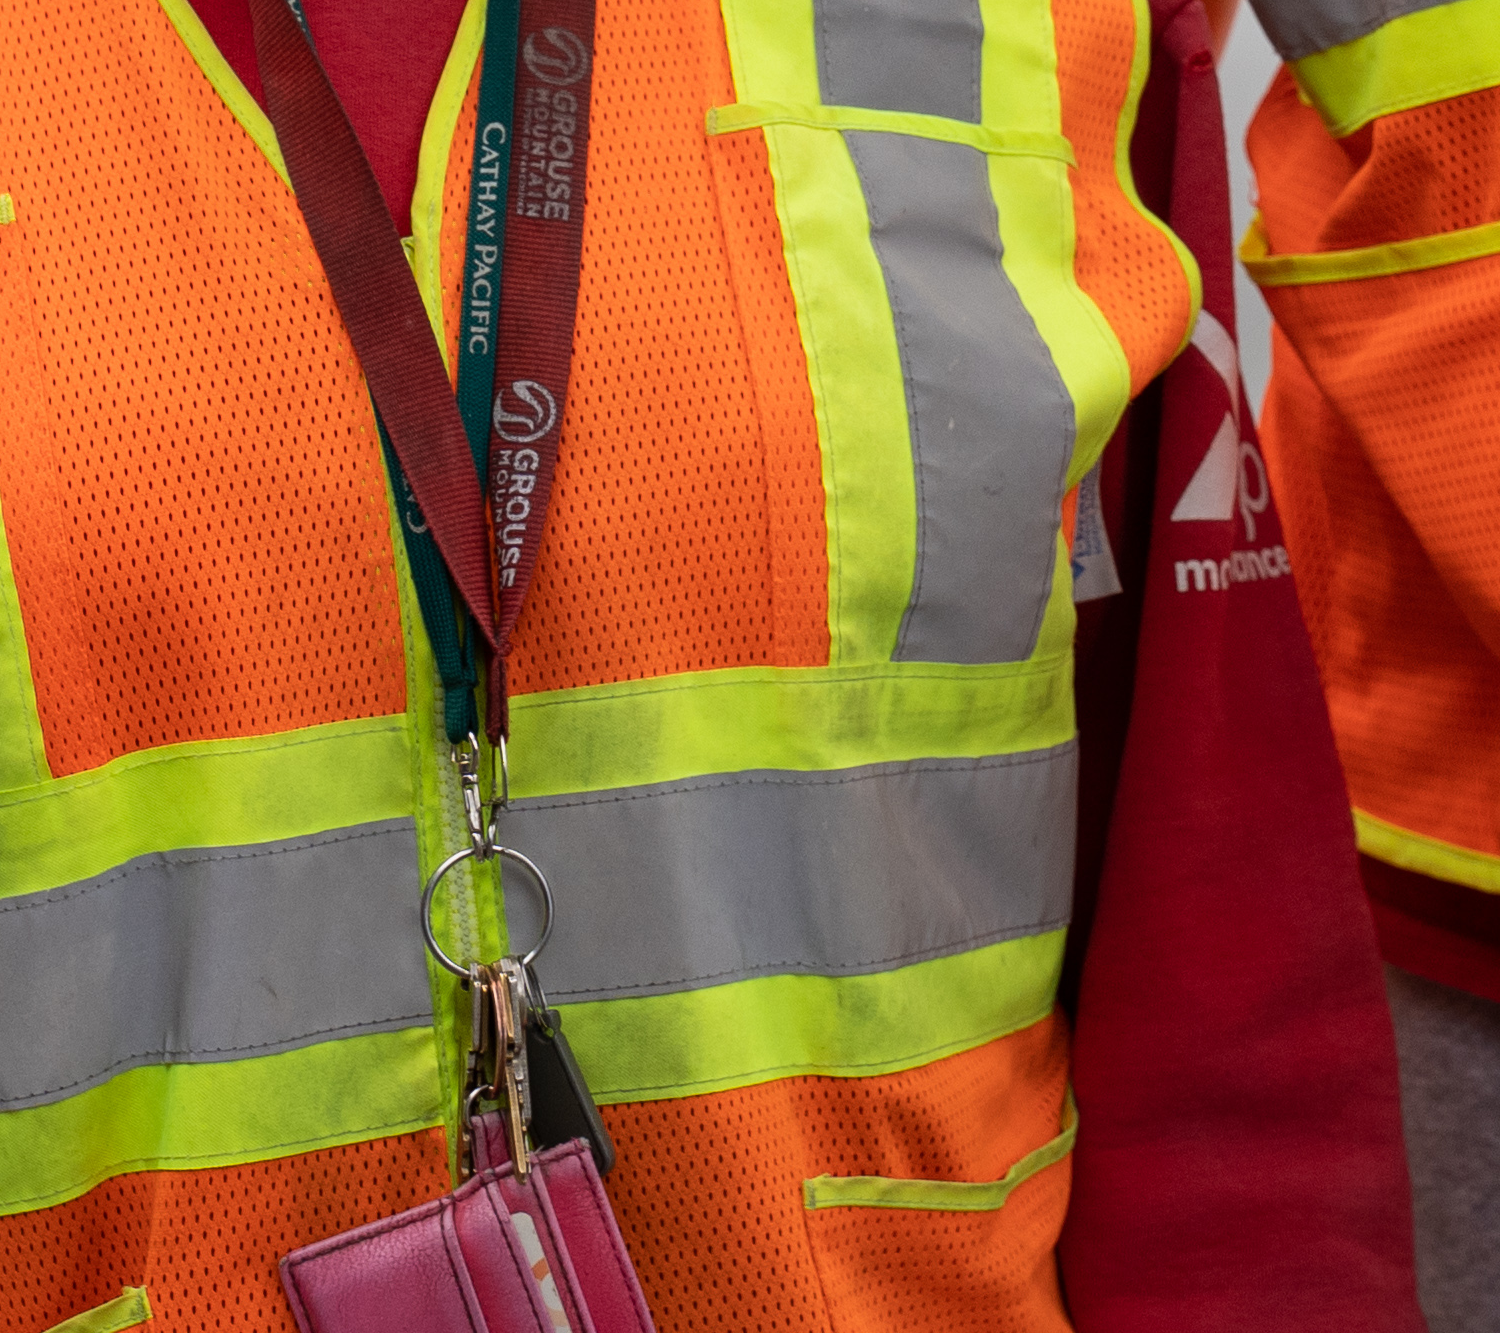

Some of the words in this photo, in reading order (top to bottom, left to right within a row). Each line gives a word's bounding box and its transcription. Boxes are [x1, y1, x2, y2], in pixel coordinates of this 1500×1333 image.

[475, 121, 506, 238] CATHAY
[526, 87, 550, 218] MOUNTAIN
[544, 90, 578, 221] GROUSE
[468, 244, 498, 355] PACIFIC
[501, 448, 540, 588] GROUSE
